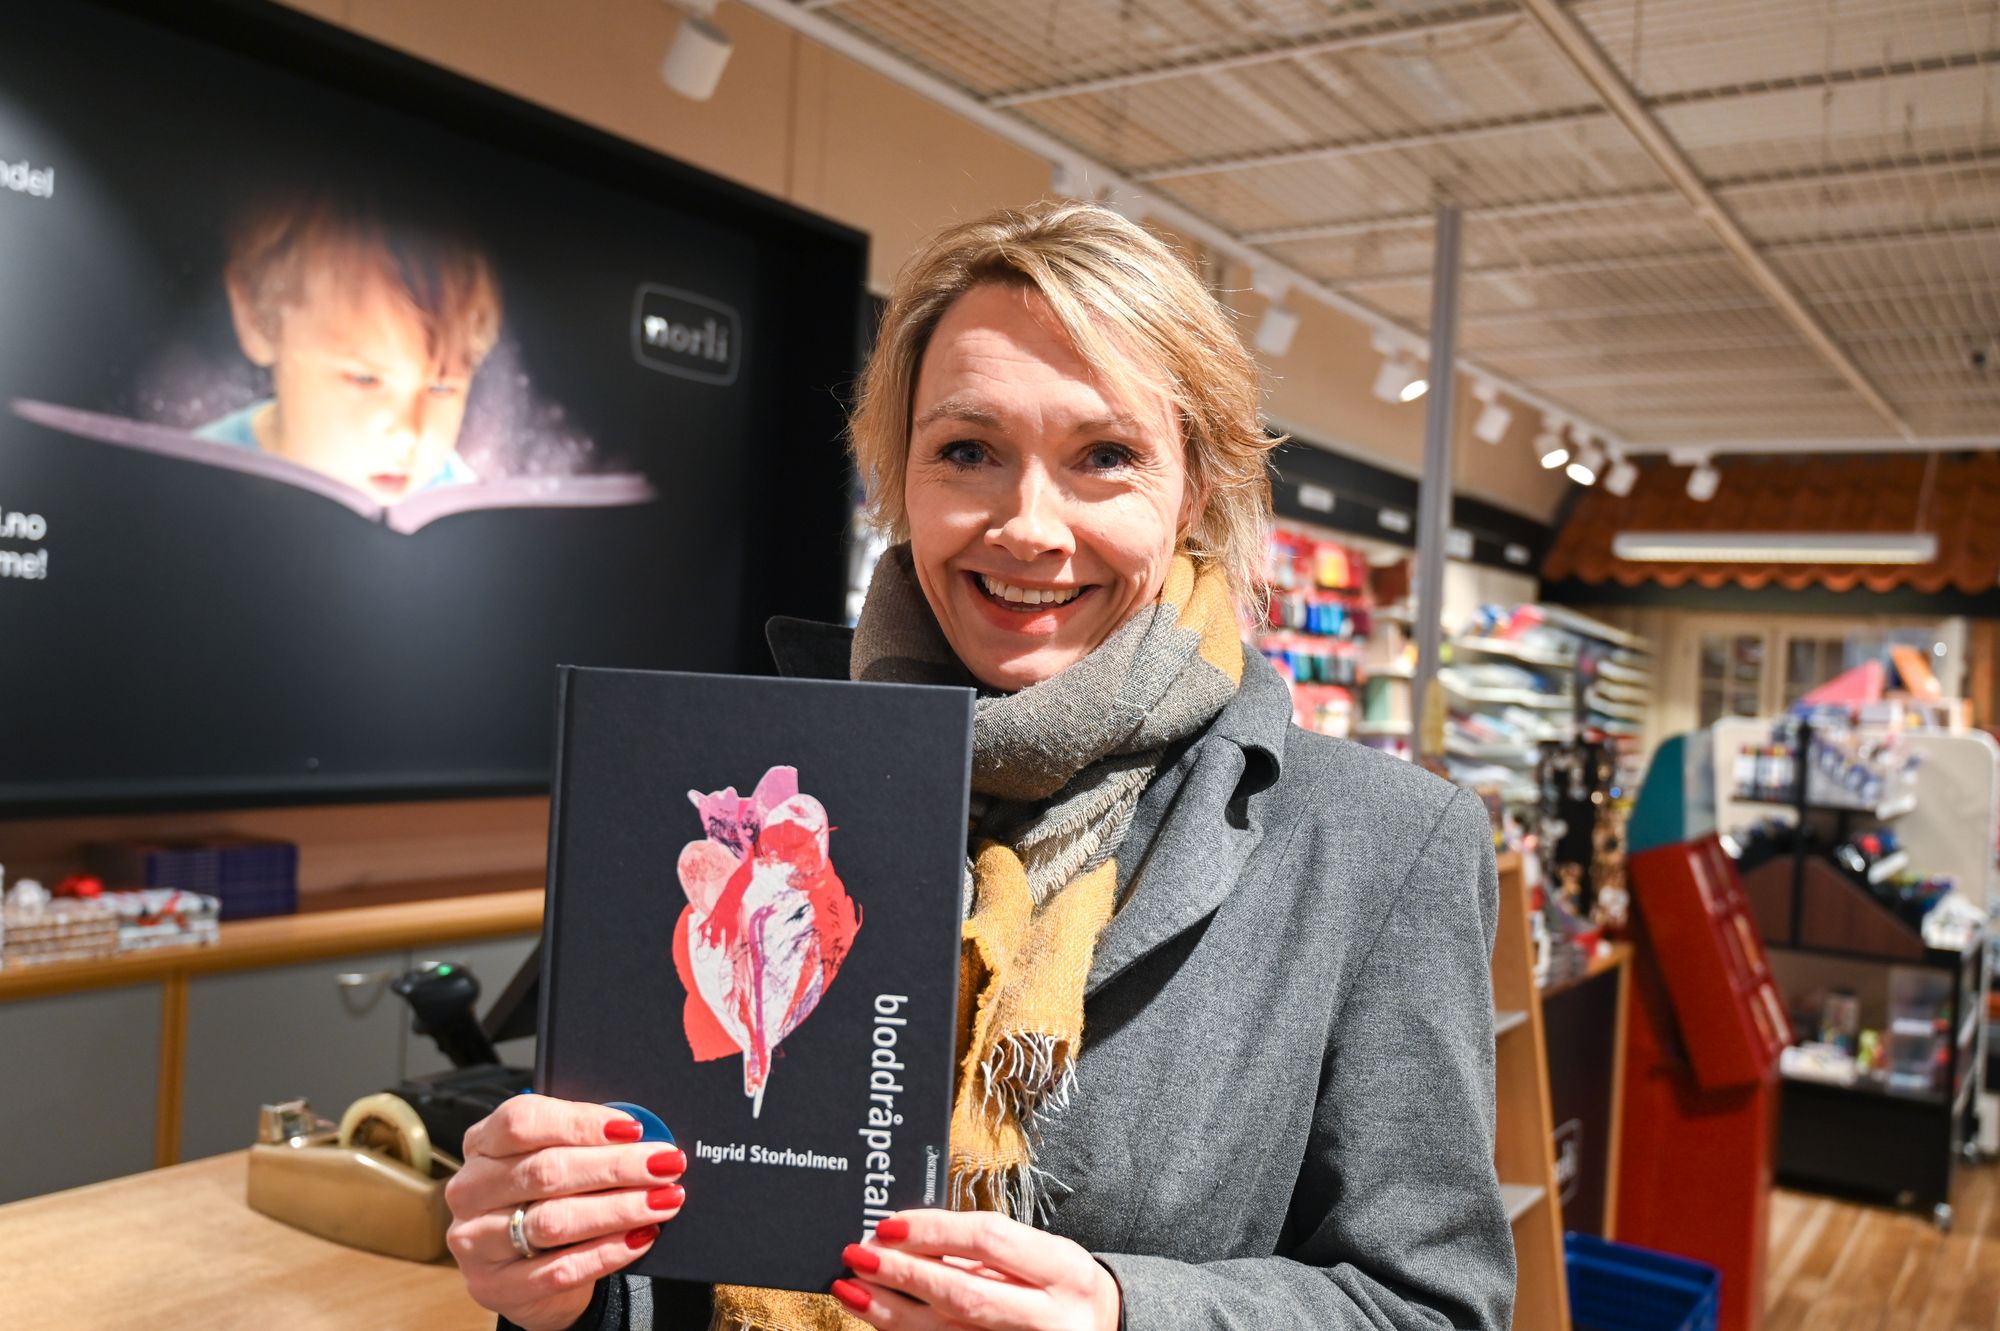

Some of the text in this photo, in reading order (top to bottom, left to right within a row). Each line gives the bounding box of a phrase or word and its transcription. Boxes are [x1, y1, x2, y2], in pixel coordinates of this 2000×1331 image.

[644, 315, 728, 363] norli
[696, 1140, 848, 1171] Ingrid Storholmen
